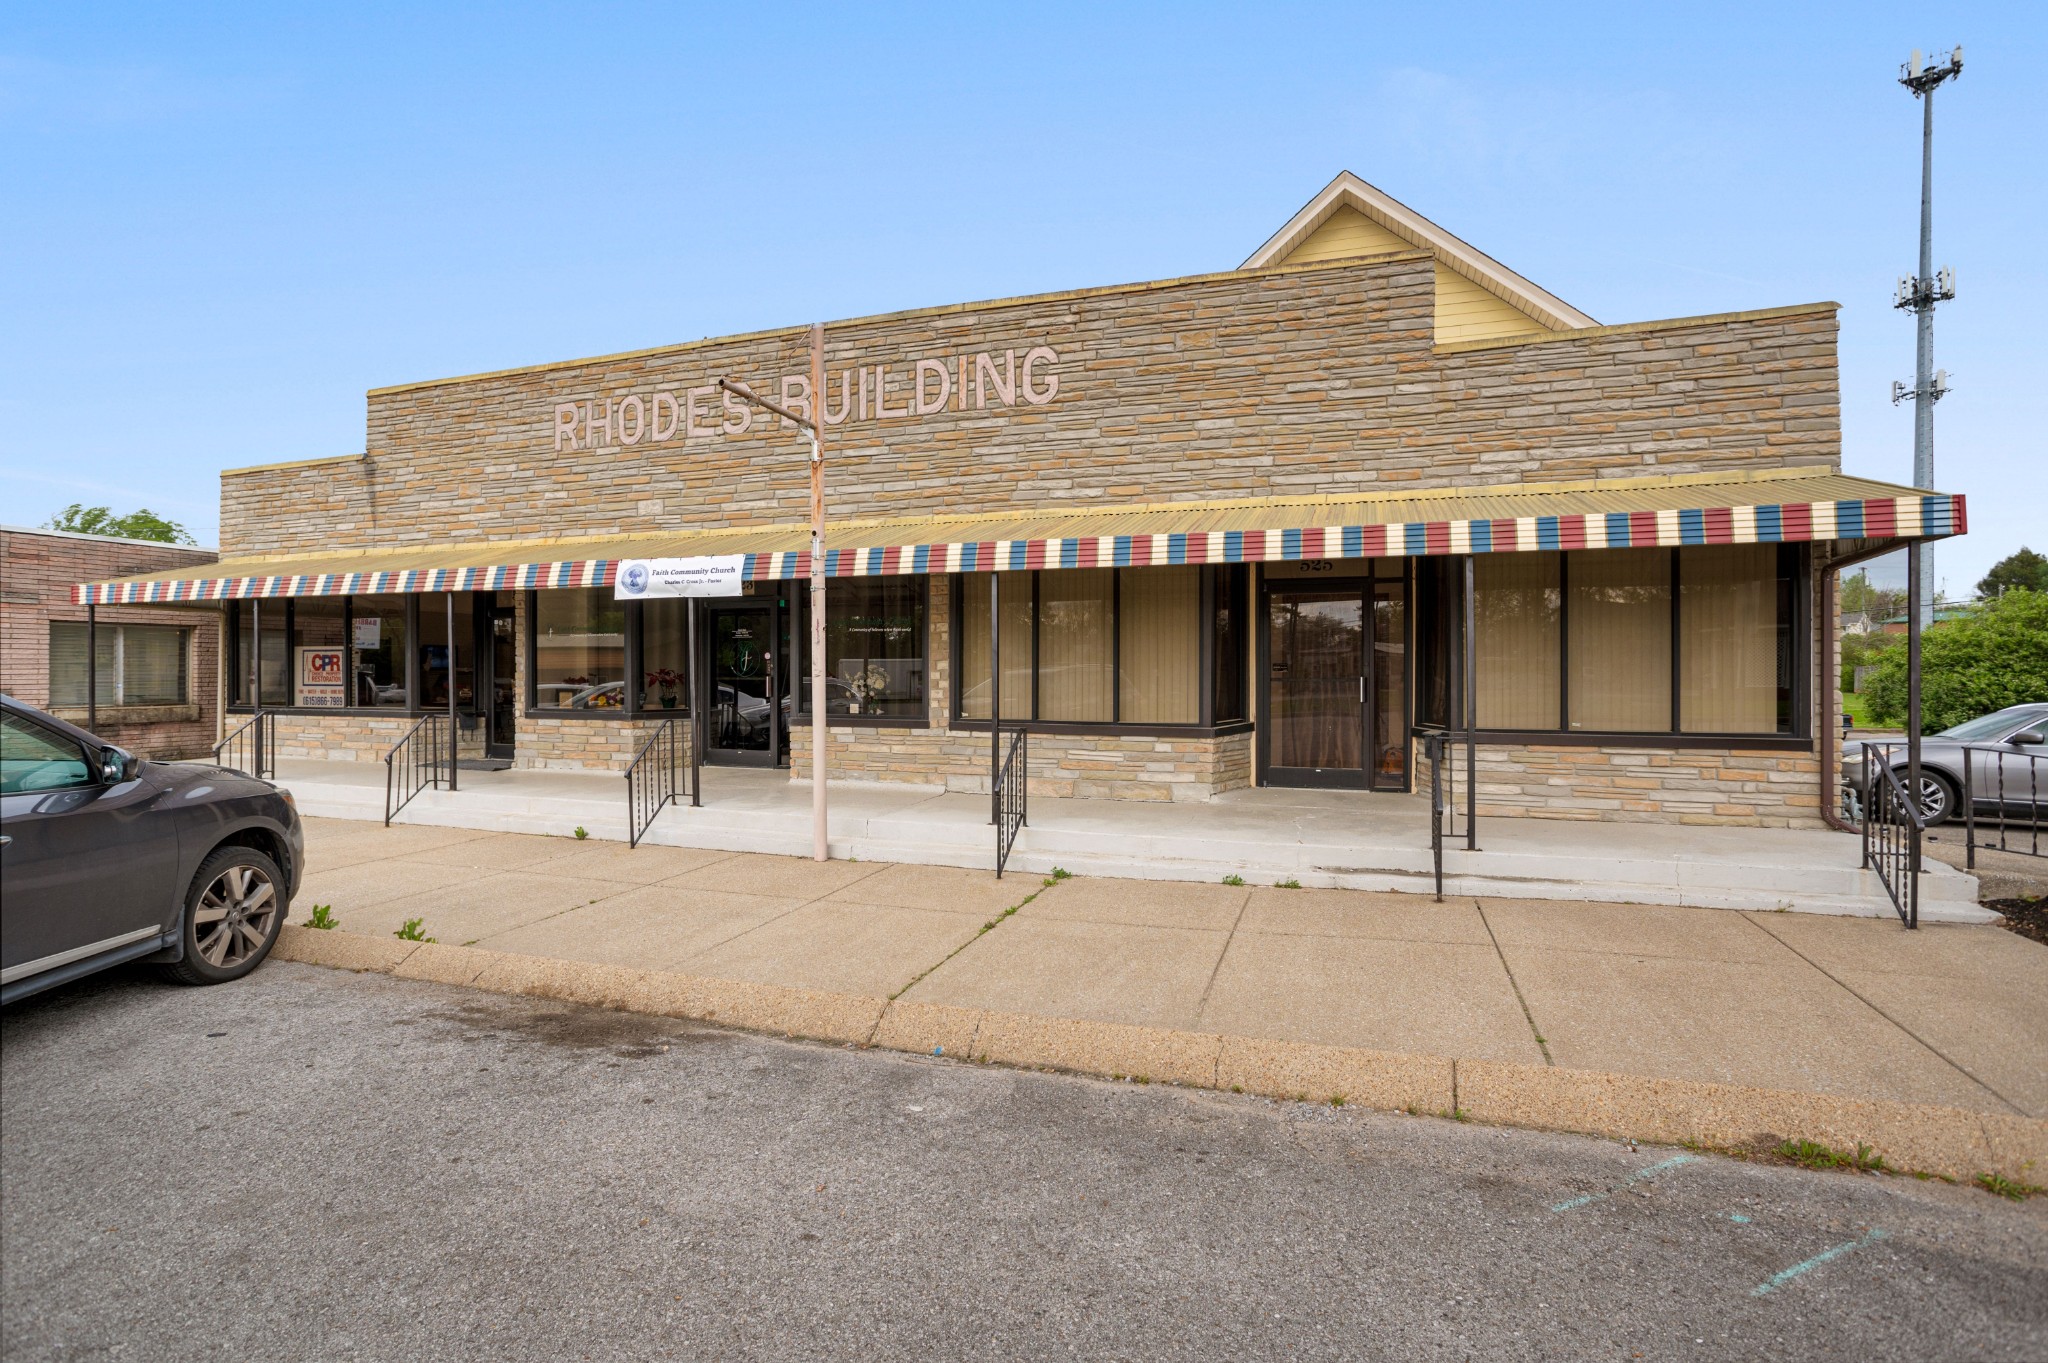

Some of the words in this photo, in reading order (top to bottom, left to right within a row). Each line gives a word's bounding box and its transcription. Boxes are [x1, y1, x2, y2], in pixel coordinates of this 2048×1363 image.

[554, 382, 753, 451] RHODES
[781, 346, 1060, 427] BUILDING
[670, 567, 709, 576] Community
[710, 566, 736, 574] Church
[1300, 560, 1333, 572] 525
[311, 653, 341, 672] CPR
[311, 675, 342, 683] RESTORATION
